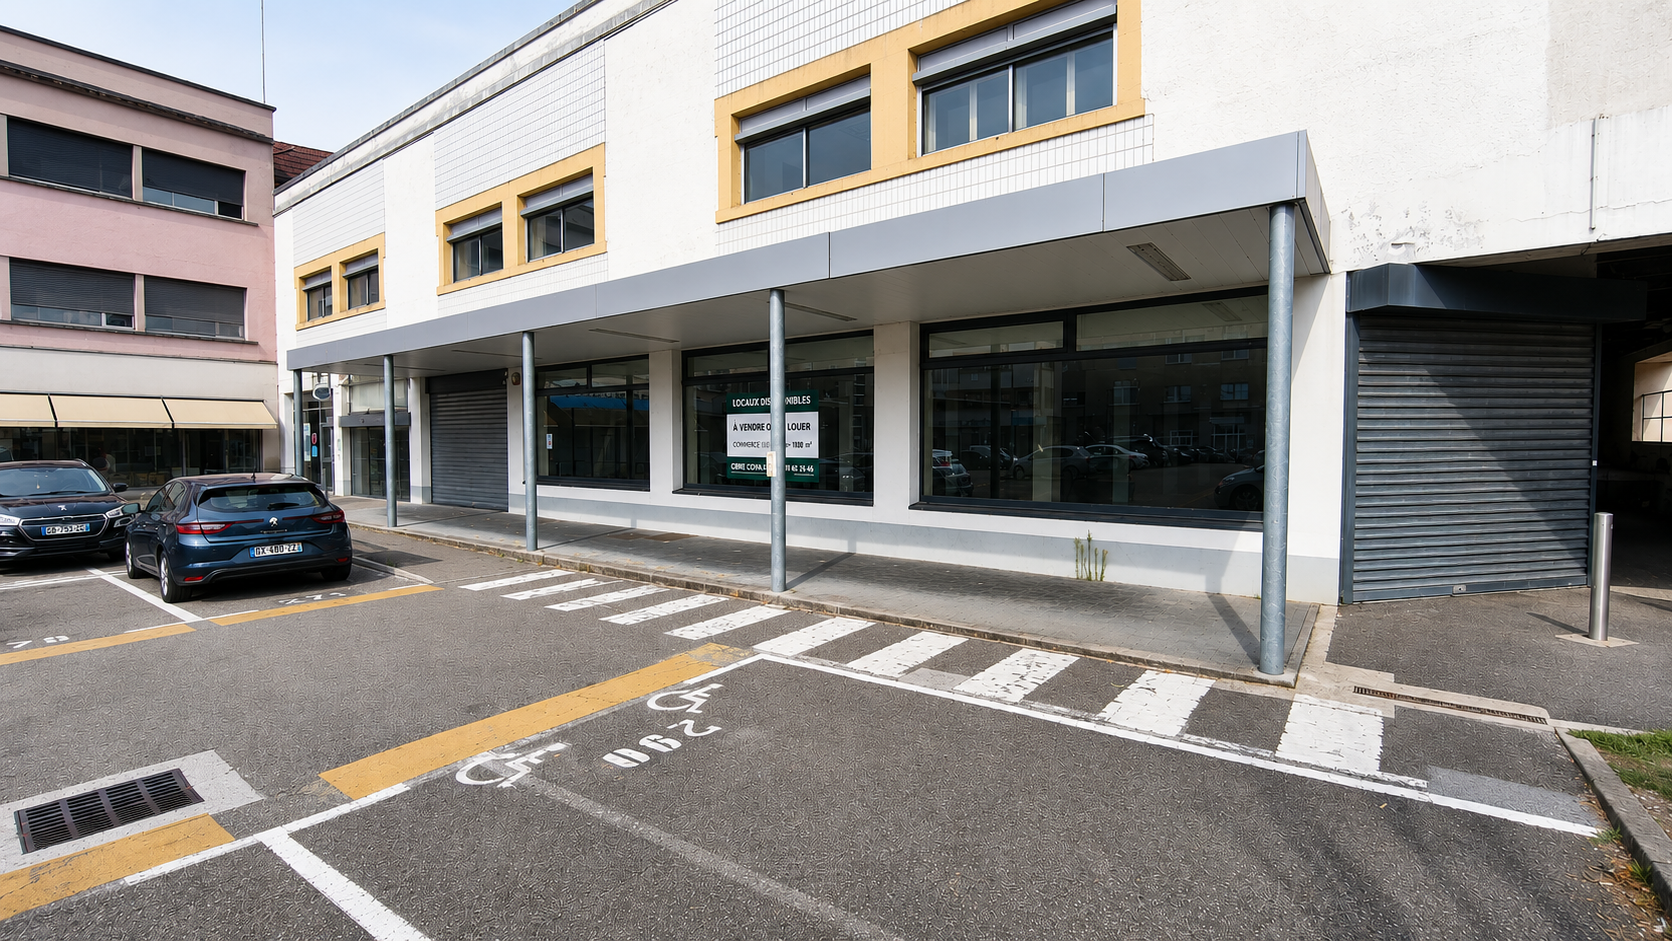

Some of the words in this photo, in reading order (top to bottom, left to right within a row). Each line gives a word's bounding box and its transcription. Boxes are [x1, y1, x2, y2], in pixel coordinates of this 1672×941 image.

[732, 398, 760, 408] LOCAUX
[739, 423, 765, 431] VENDRE
[787, 423, 811, 431] LOUER
